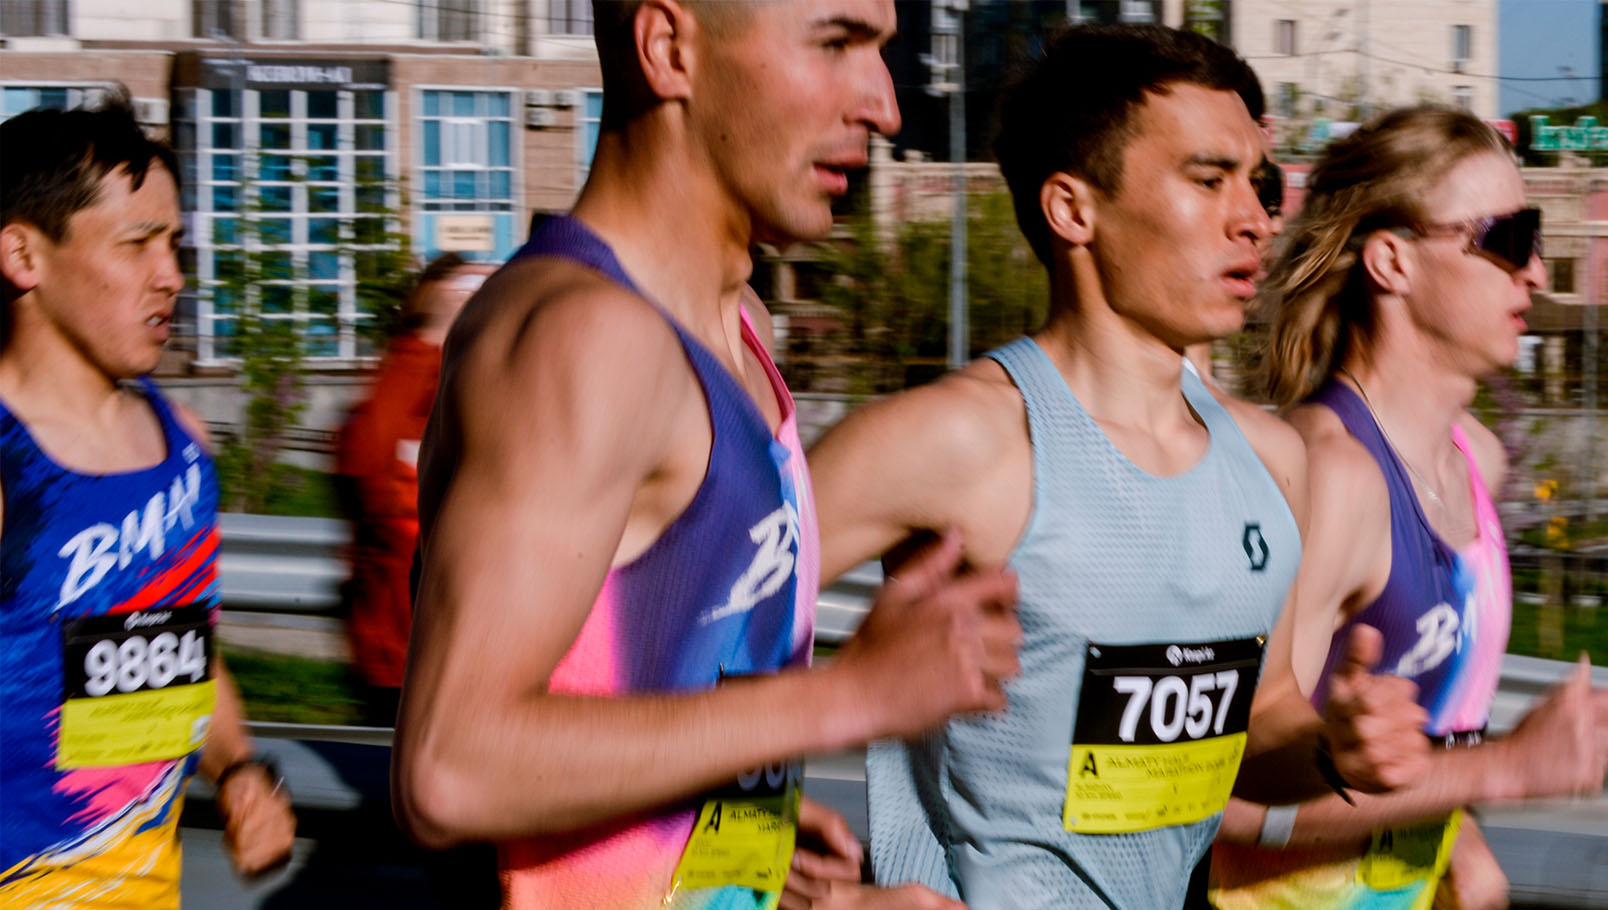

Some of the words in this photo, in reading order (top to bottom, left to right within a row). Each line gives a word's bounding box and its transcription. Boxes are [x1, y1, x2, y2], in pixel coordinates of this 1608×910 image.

[84, 630, 206, 697] 9864
[1113, 669, 1239, 742] 7057
[1079, 751, 1099, 778] A
[703, 801, 723, 834] A
